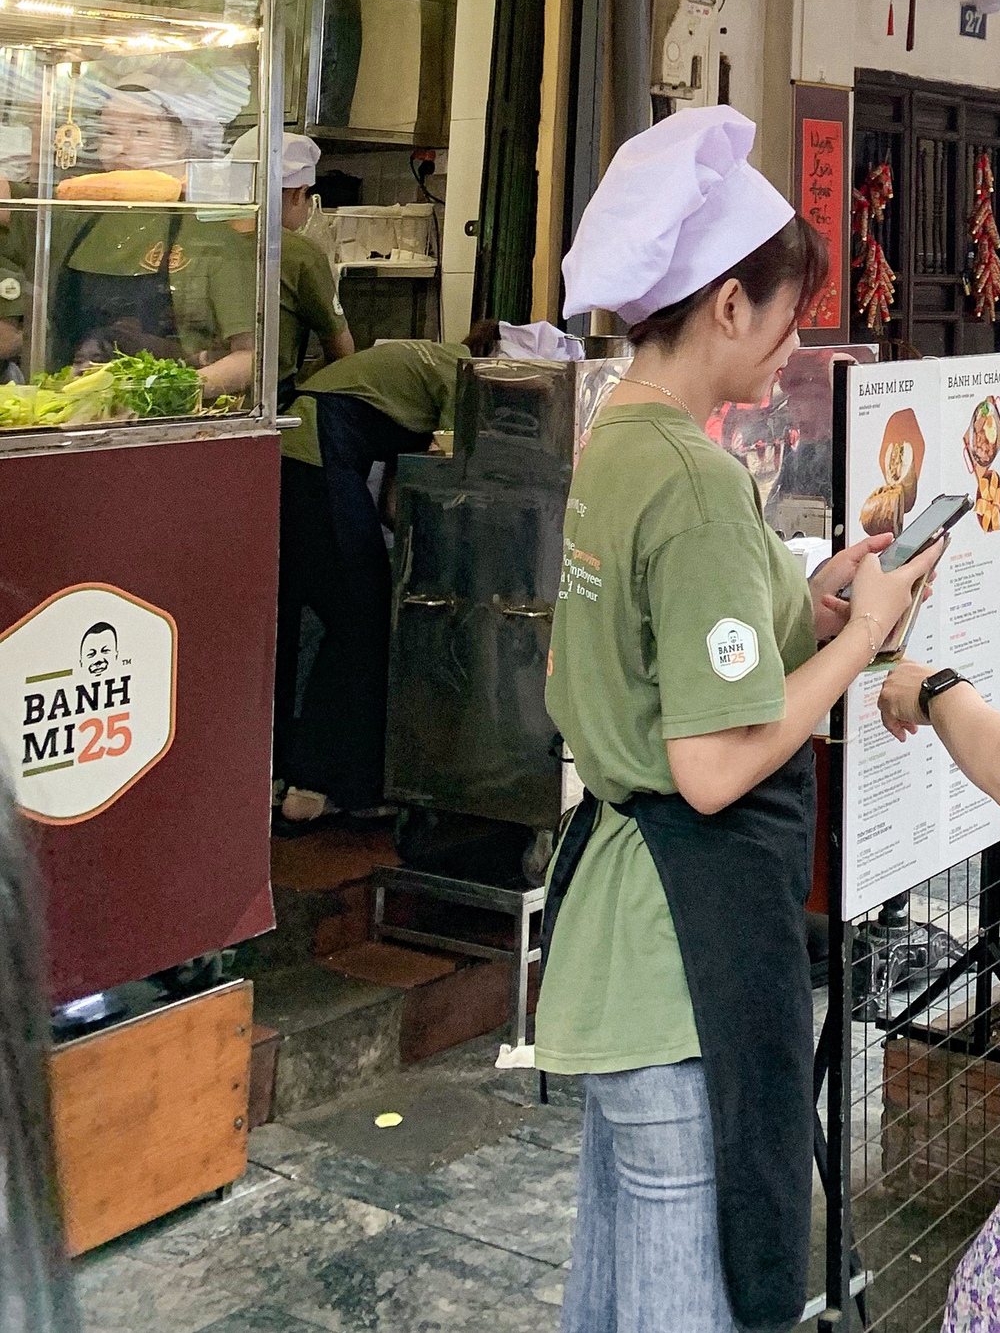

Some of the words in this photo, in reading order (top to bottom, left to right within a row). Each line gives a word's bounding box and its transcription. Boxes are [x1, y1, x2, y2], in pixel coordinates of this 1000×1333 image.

[965, 10, 983, 34] 27
[947, 373, 971, 388] BÁNH
[570, 566, 603, 587] mployees
[718, 643, 744, 655] BANH
[23, 675, 131, 726] BANH
